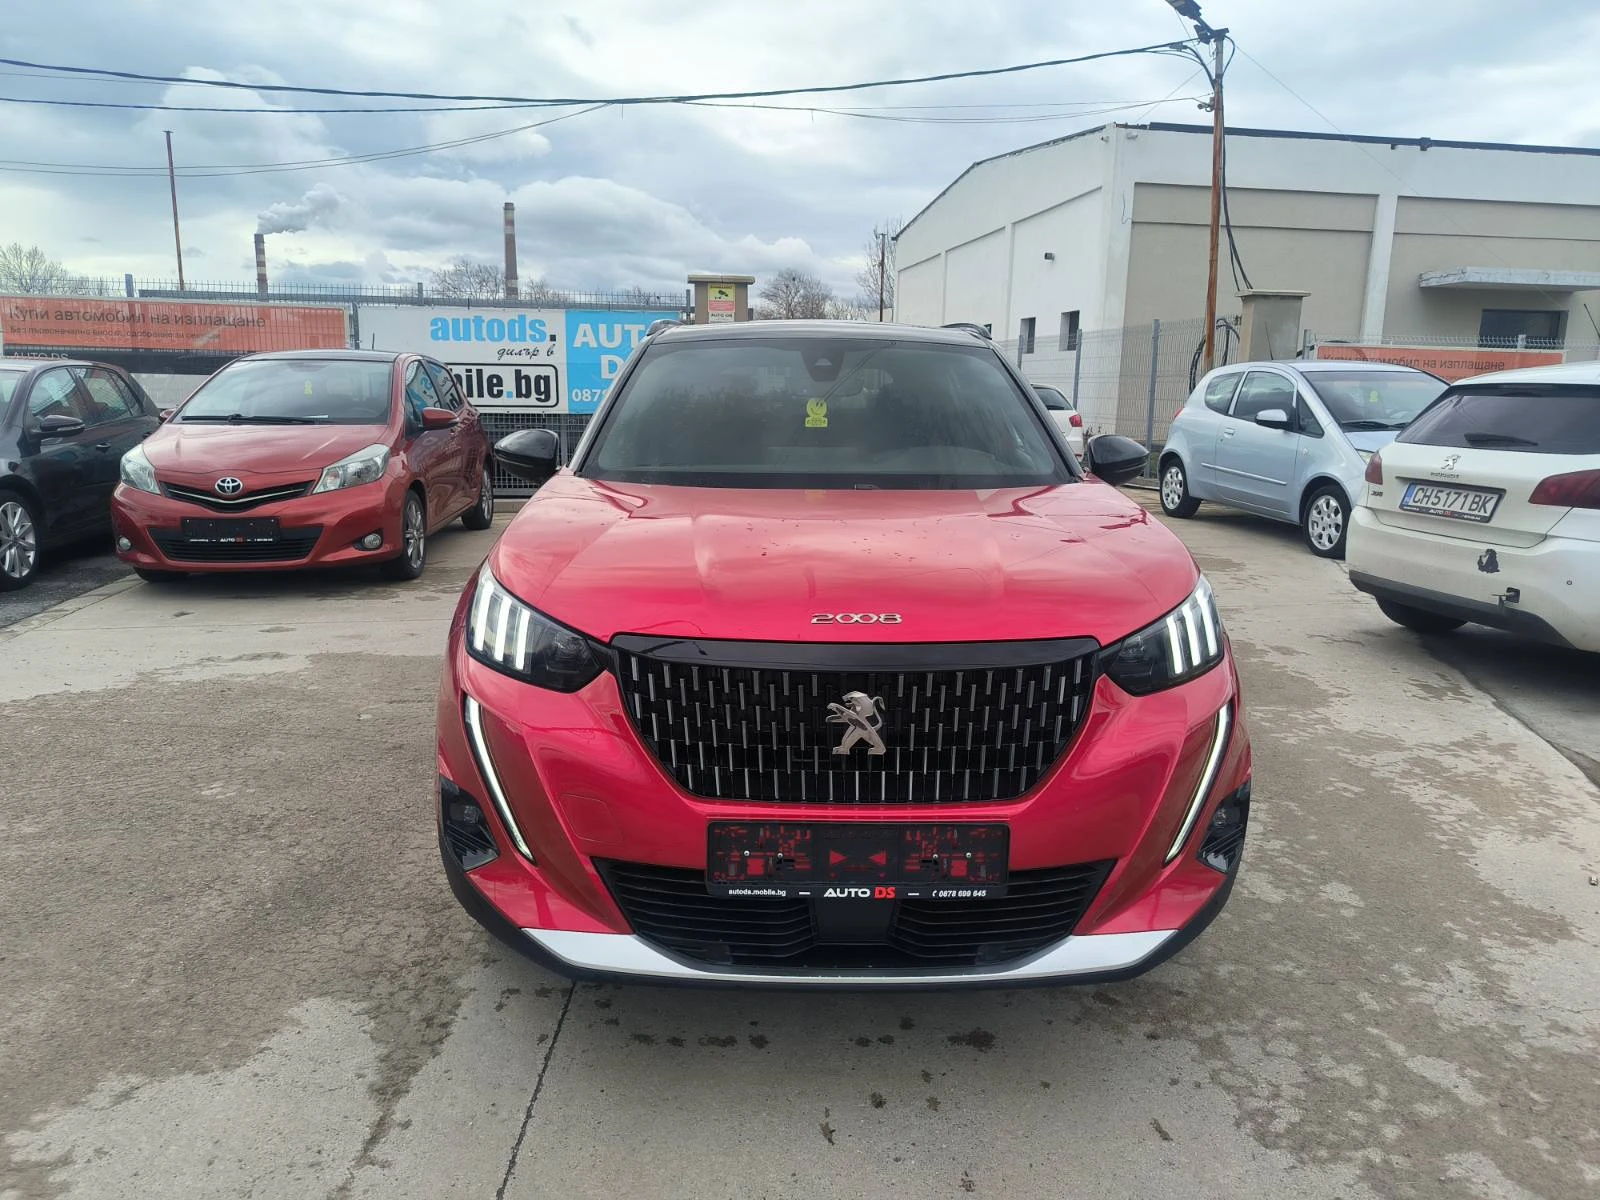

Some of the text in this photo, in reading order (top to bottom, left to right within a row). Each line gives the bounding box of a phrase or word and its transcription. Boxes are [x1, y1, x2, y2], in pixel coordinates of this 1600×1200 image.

[9, 306, 266, 329] Купи автомобил на изплащане
[430, 313, 557, 343] autods.
[497, 346, 540, 360] дилър
[1423, 359, 1437, 369] на
[1440, 359, 1505, 371] изплащане
[810, 612, 903, 624] 2008
[823, 888, 871, 898] AUTO
[873, 886, 896, 899] DS
